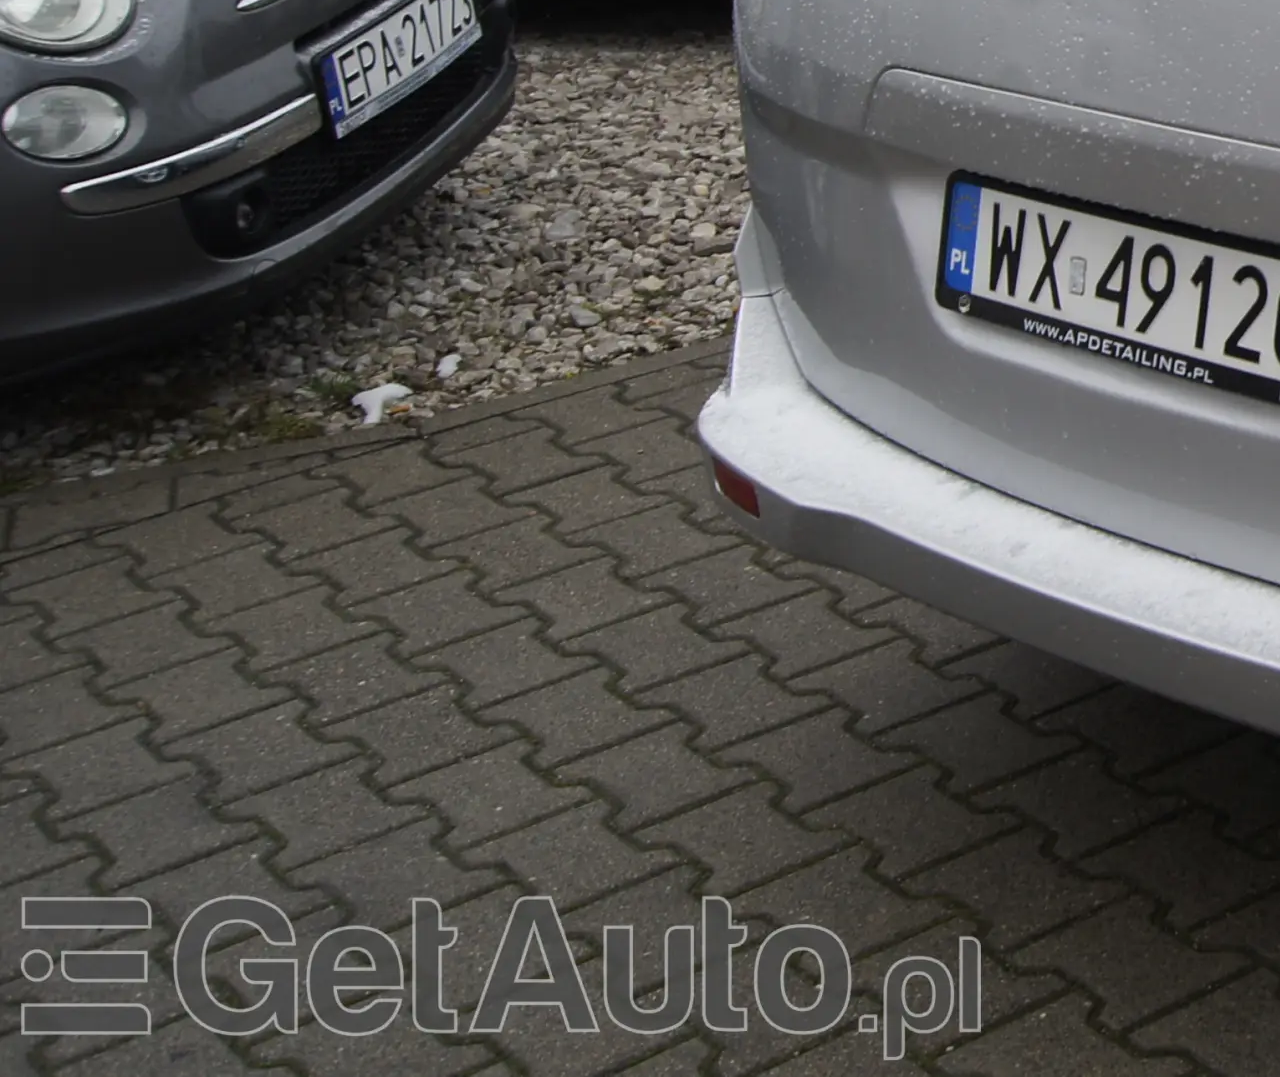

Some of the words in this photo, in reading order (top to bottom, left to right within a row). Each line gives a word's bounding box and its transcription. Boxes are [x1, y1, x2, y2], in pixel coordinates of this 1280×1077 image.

[338, 29, 402, 108] EPA
[949, 248, 970, 276] PL
[989, 202, 1071, 310] WX
